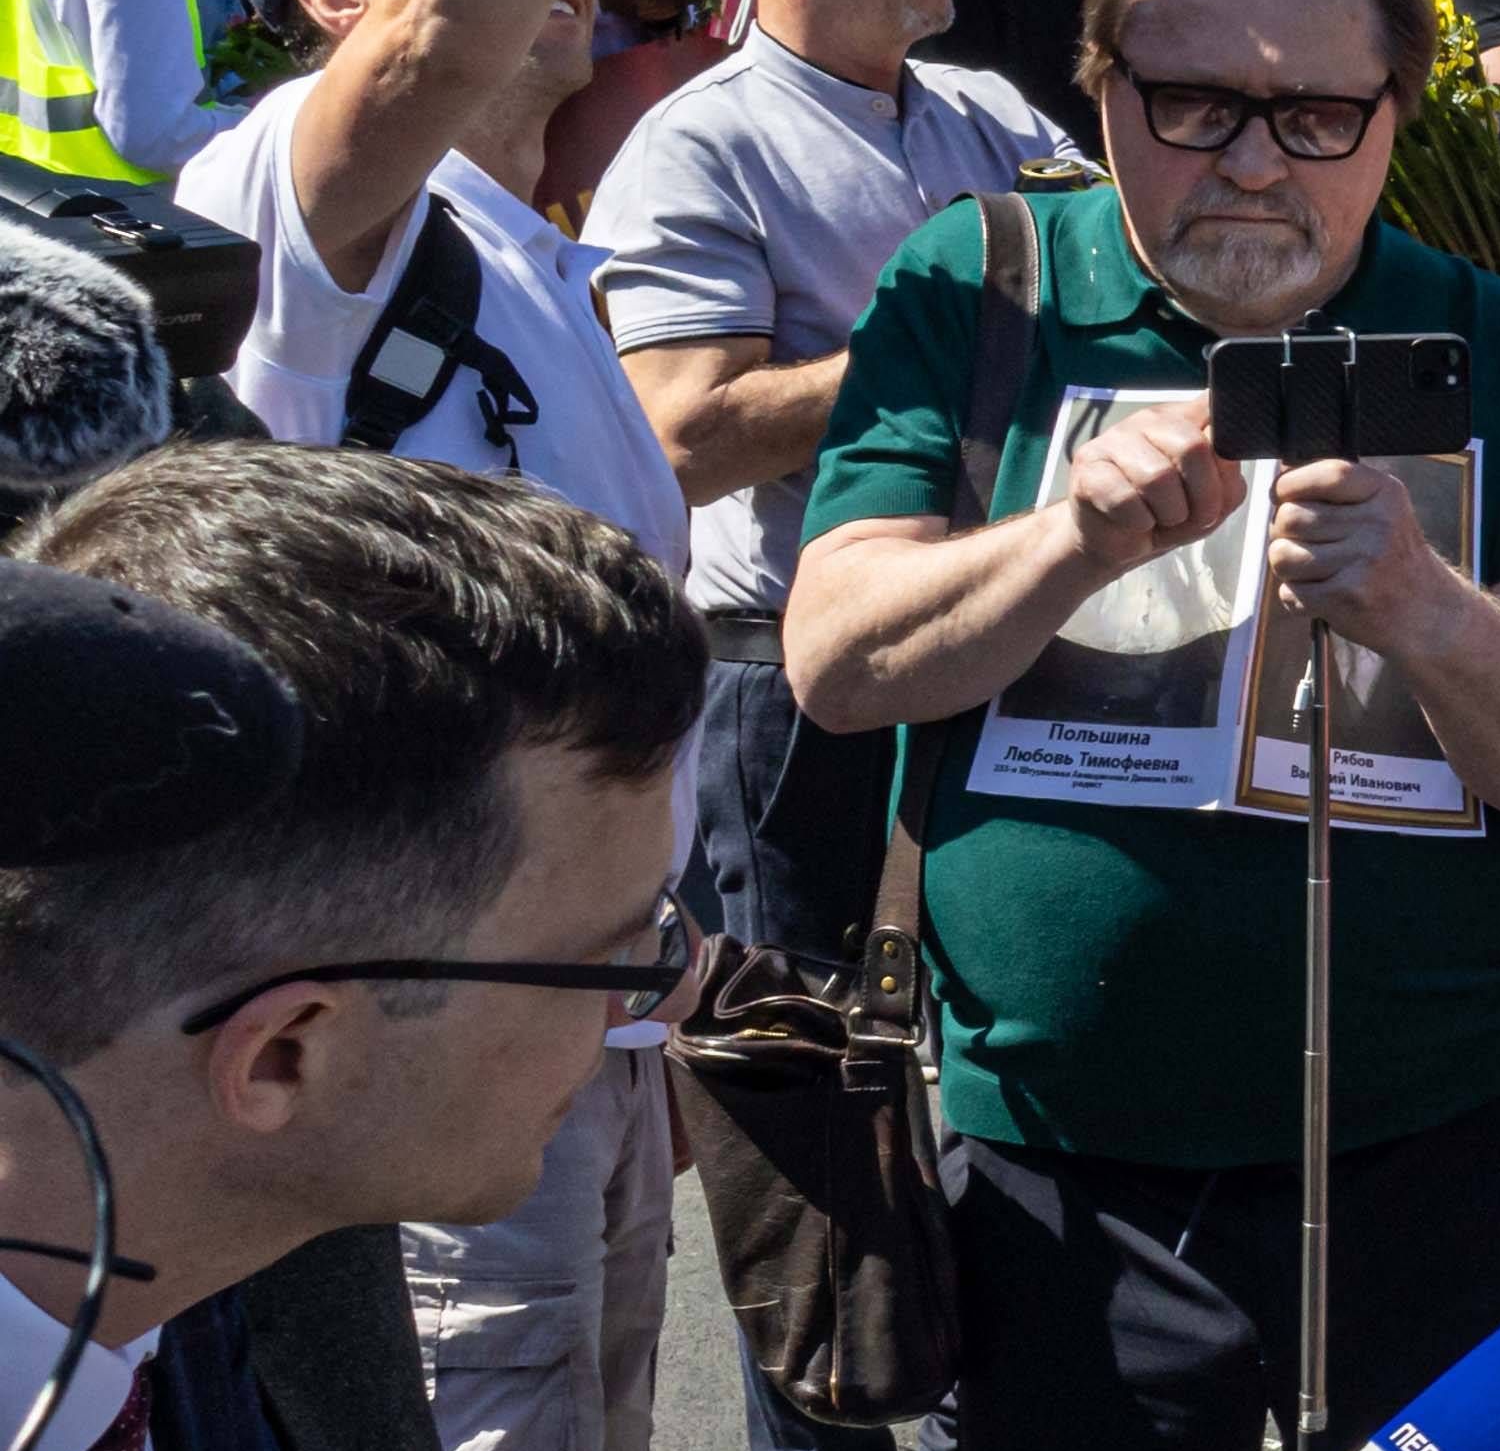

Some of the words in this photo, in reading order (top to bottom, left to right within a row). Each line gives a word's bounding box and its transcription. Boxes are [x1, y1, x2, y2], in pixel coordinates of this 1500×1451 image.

[1048, 723, 1151, 746] Польшина
[1003, 745, 1074, 766] Любовь
[1079, 751, 1180, 773] Тимофеевна
[1333, 751, 1375, 769] Рябов
[1350, 773, 1422, 794] Иванович
